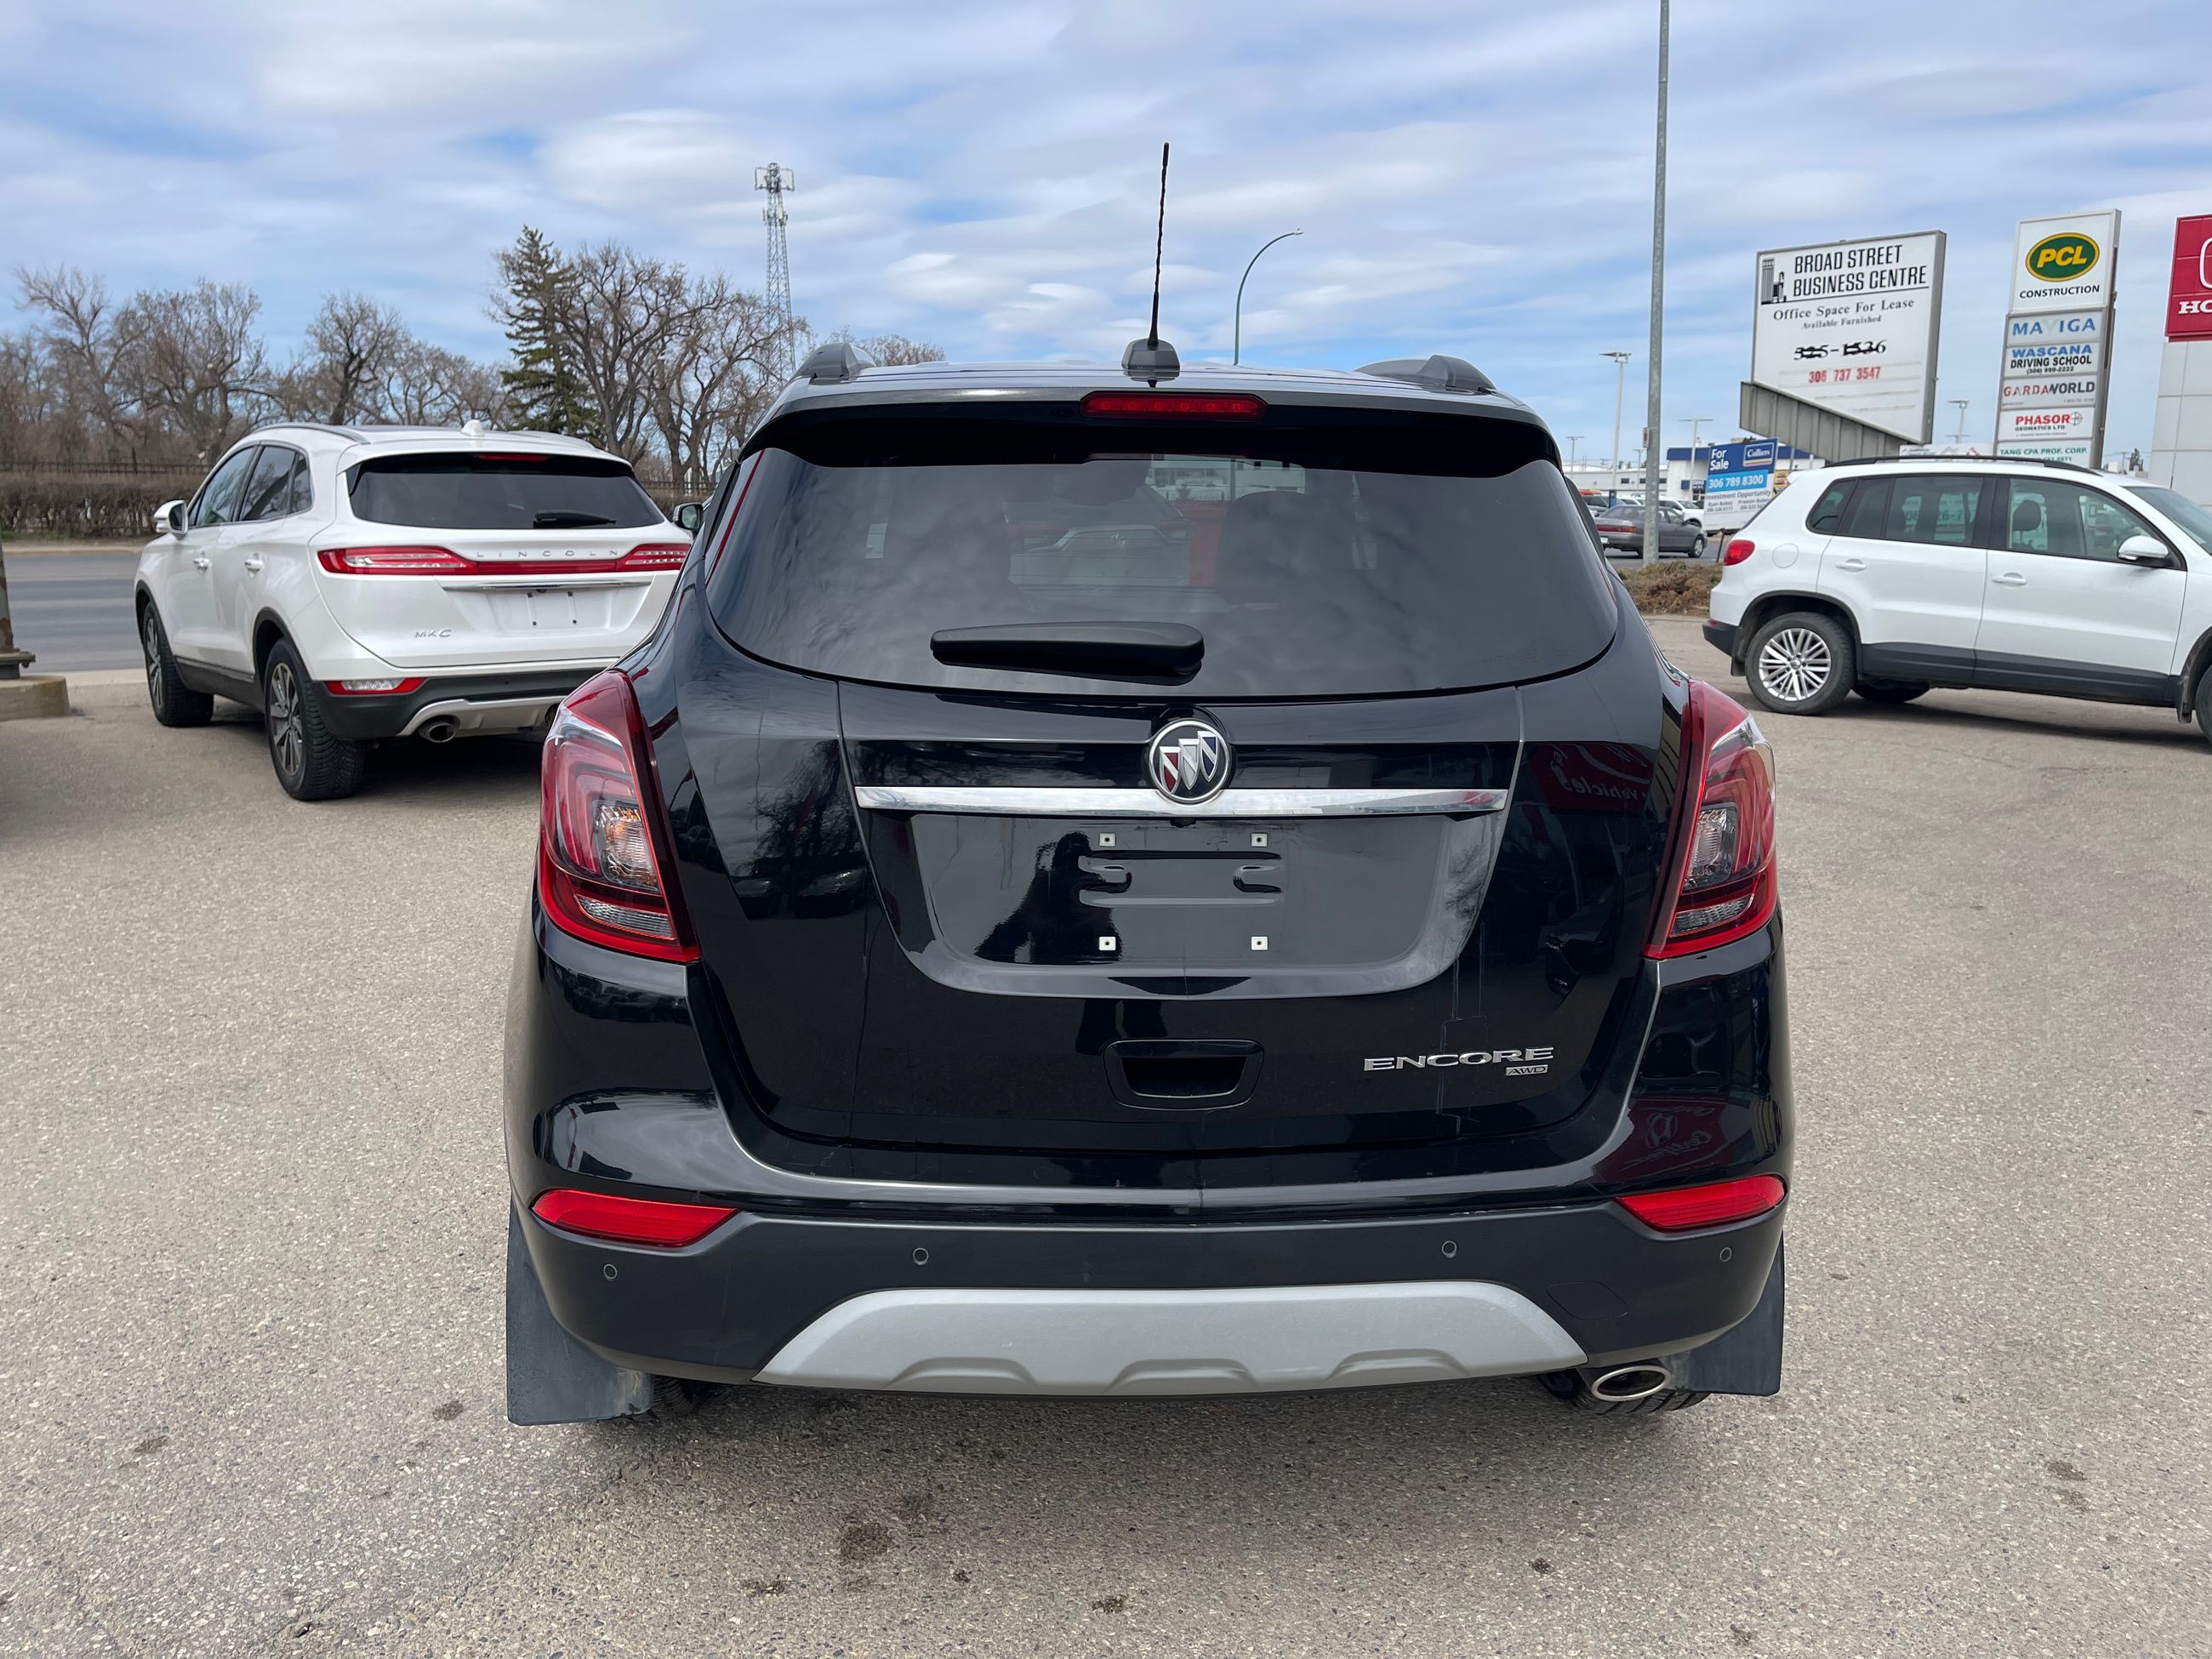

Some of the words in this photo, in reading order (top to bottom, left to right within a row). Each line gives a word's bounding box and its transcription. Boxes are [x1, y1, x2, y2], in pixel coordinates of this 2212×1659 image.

[1794, 251, 1843, 274] BROAD
[1848, 244, 1903, 268] STREET
[2037, 245, 2087, 269] PCL
[1793, 271, 1864, 297] BUSINESS
[1869, 265, 1927, 289] CENTRE
[2020, 284, 2101, 299] CONSTRUCTION
[1773, 308, 1812, 321] Office
[1816, 305, 1850, 318] Space
[1856, 302, 1875, 313] For
[1881, 299, 1914, 311] Lease
[1802, 319, 1838, 329] Available
[1841, 315, 1882, 326] Furnished
[2011, 345, 2092, 358] WASCANA
[2010, 357, 2050, 368] DRIVING
[2052, 356, 2092, 367] SCHOOL
[1809, 370, 1827, 383] 306
[1834, 368, 1851, 382] 737
[1856, 366, 1882, 380] 3547
[2015, 414, 2071, 425] PHASOR
[1711, 448, 1727, 459] For
[1710, 459, 1729, 471] Sale
[1708, 478, 1724, 489] 306
[1725, 476, 1741, 487] 789
[1742, 475, 1764, 486] 8300
[1736, 490, 1770, 499] Opportunity
[414, 629, 453, 638] MKC
[1364, 1046, 1554, 1072] ENCORE
[1507, 1065, 1547, 1075] AWD
